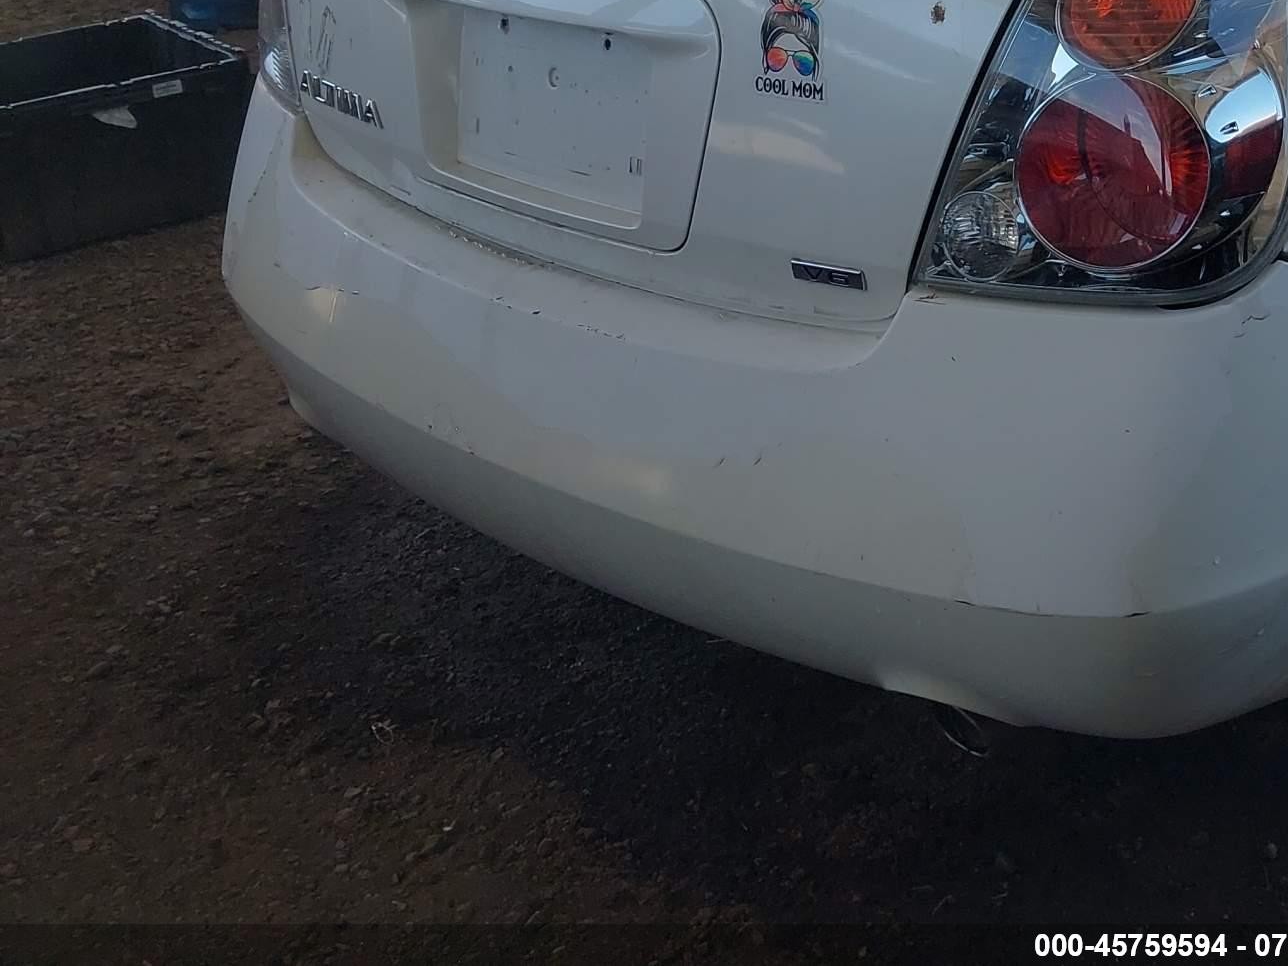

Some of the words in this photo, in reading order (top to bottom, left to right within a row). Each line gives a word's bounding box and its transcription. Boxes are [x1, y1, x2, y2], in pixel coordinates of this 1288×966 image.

[300, 69, 384, 129] ALTIMA
[755, 76, 789, 96] COOL
[791, 80, 824, 101] MOM
